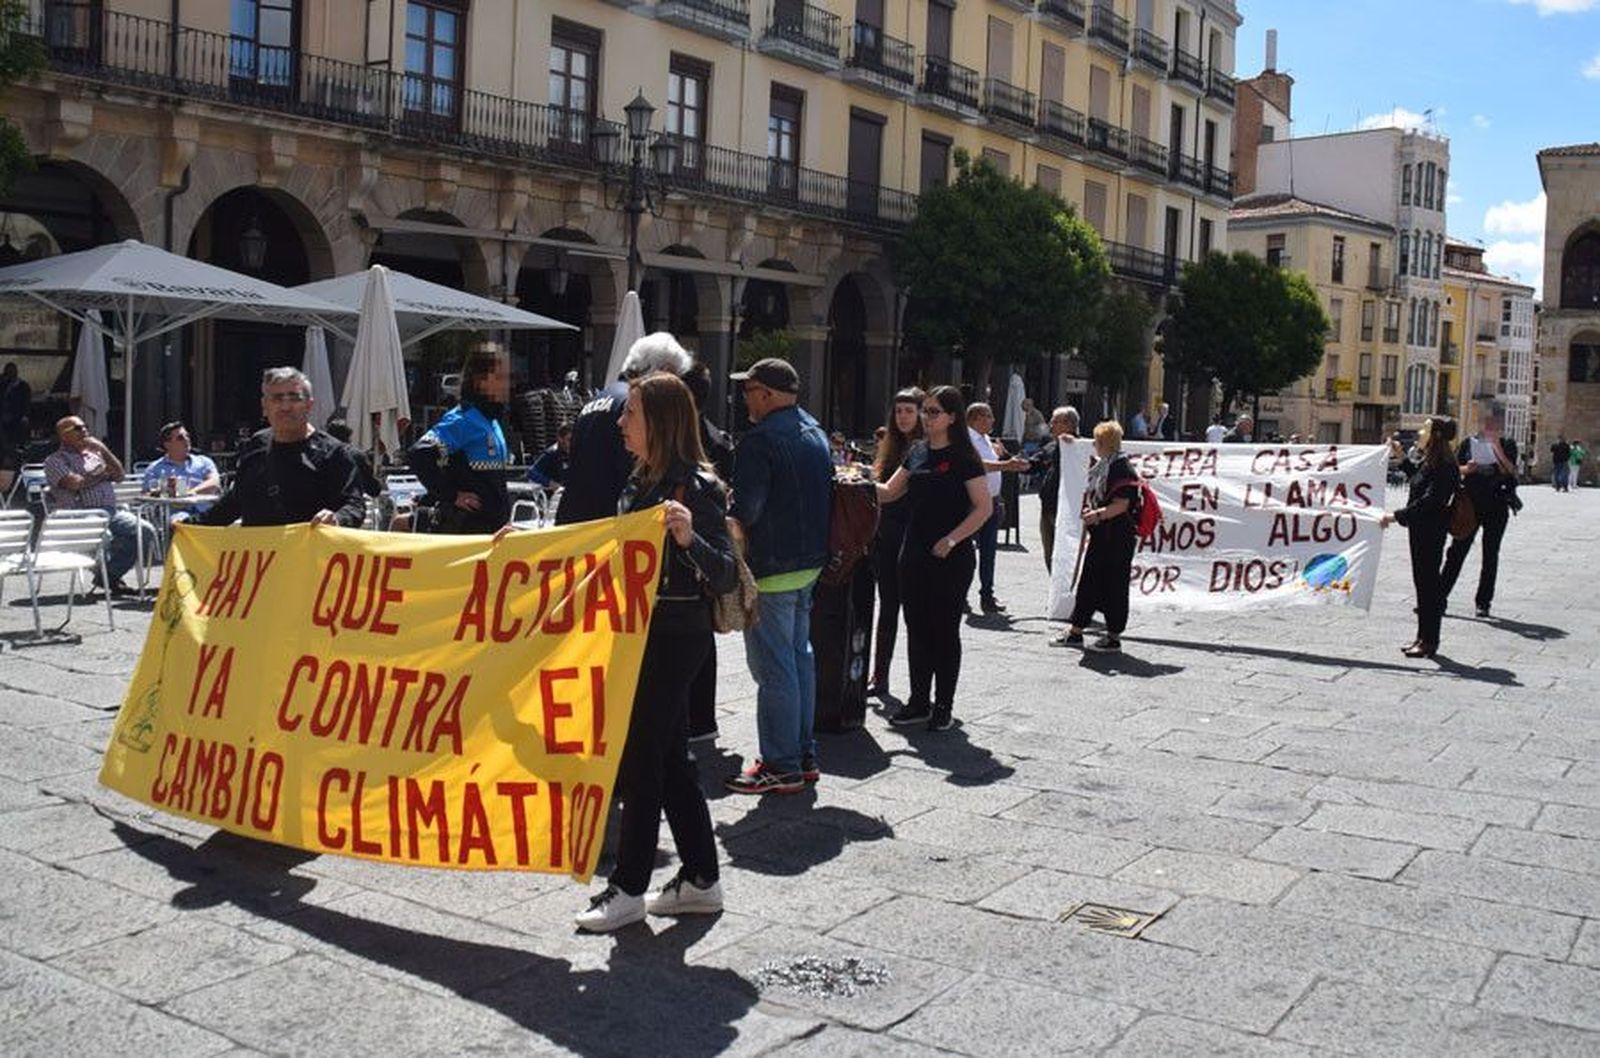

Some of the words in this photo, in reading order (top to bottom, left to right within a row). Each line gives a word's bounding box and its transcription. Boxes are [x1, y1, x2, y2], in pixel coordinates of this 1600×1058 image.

[1180, 483, 1219, 512] EN
[1244, 480, 1373, 510] LLAMAS
[1251, 446, 1339, 476] CASA
[1137, 517, 1216, 554] AMOS
[1268, 512, 1358, 547] ALGO
[197, 549, 277, 621] HAY
[311, 551, 413, 637] QUE
[453, 539, 657, 643] ACTUAR
[187, 645, 235, 719] YA
[277, 655, 472, 756] CONTRA
[316, 763, 604, 876] CLIMÁTICO
